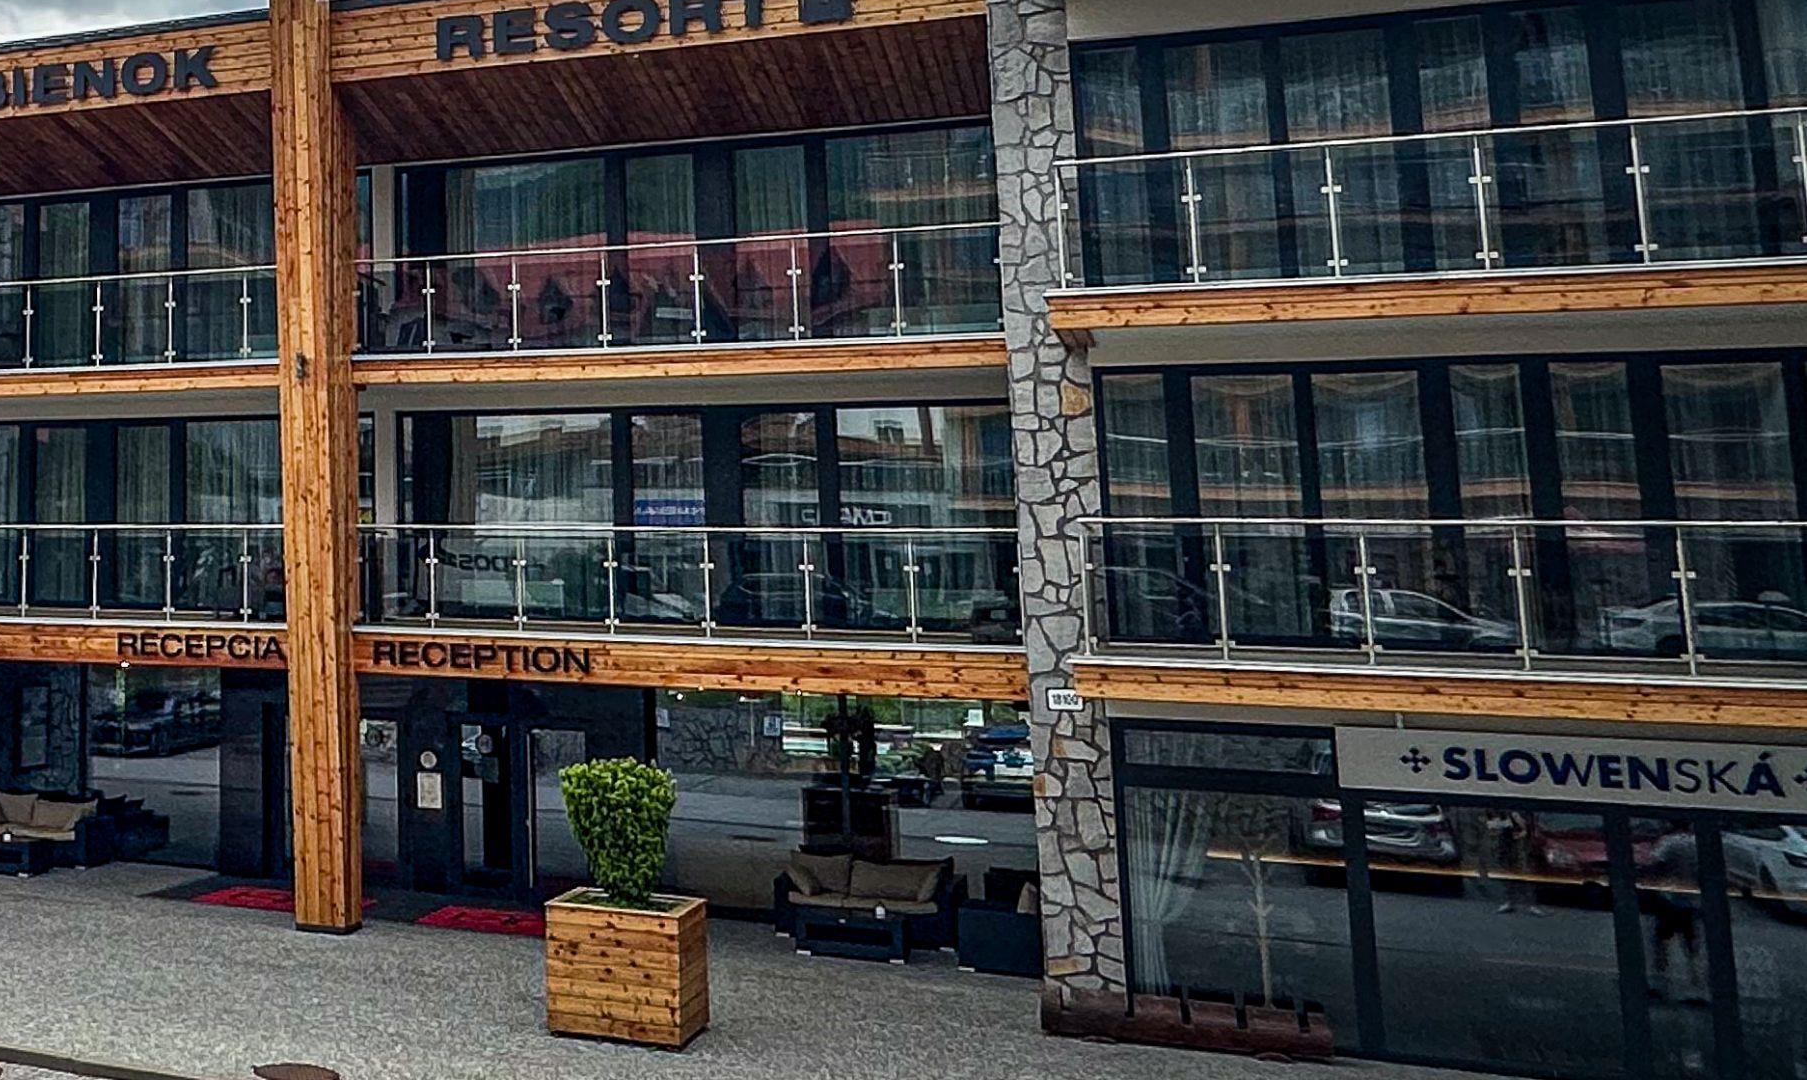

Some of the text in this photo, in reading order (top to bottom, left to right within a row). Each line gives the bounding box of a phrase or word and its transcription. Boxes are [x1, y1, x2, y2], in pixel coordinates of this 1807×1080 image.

[117, 632, 288, 661] RECEPCIA
[372, 640, 592, 675] RECEPTION
[1443, 746, 1786, 799] SLOWENSKÁ
